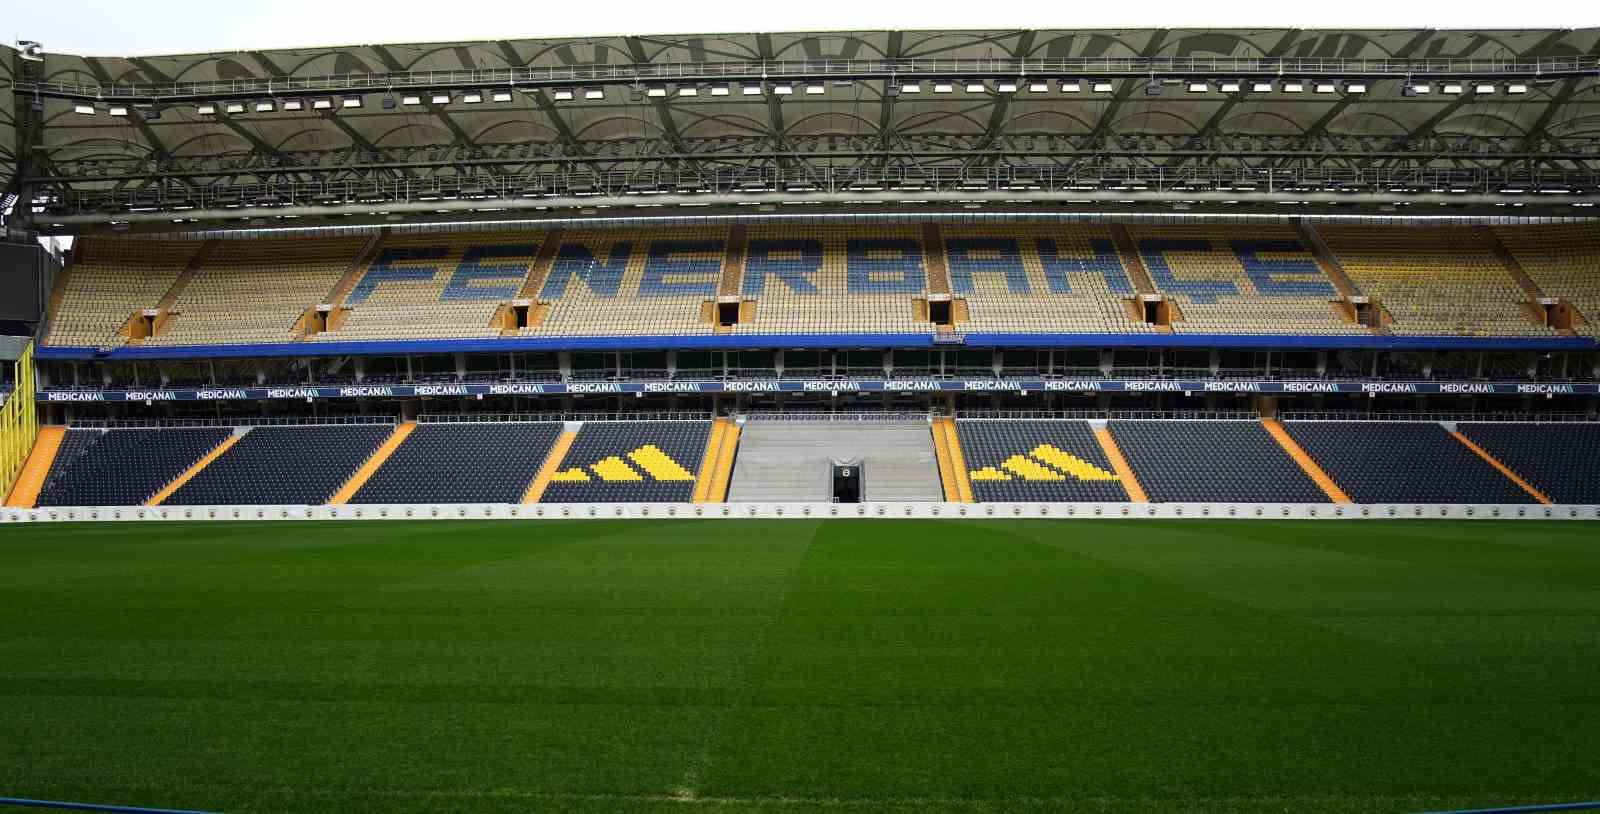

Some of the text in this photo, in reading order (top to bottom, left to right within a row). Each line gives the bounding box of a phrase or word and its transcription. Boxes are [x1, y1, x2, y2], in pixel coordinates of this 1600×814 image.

[346, 238, 1337, 305] FENERBAHÇE
[490, 384, 539, 393] MEDICANA
[566, 383, 616, 392] MEDICANA
[644, 382, 694, 392] MEDICANA
[724, 382, 774, 392] MEDICANA
[804, 381, 854, 391] MEDICANA
[884, 381, 935, 390] MEDICANA
[965, 381, 1015, 390] MEDICANA
[1045, 381, 1095, 390] MEDICANA
[1125, 381, 1176, 390] MEDICANA
[1205, 382, 1254, 391] MEDICANA
[1284, 382, 1333, 392] MEDICANA
[1362, 383, 1412, 391] MEDICANA
[1440, 384, 1488, 392] MEDICANA
[1518, 384, 1567, 392] MEDICANA
[197, 390, 241, 398] MEDICANA
[268, 389, 313, 397] MEDICANA
[340, 387, 387, 396] MEDICANA
[414, 386, 462, 396] MEDICANA
[49, 392, 98, 400] MEDICANA
[126, 392, 171, 400] MEDICANA
